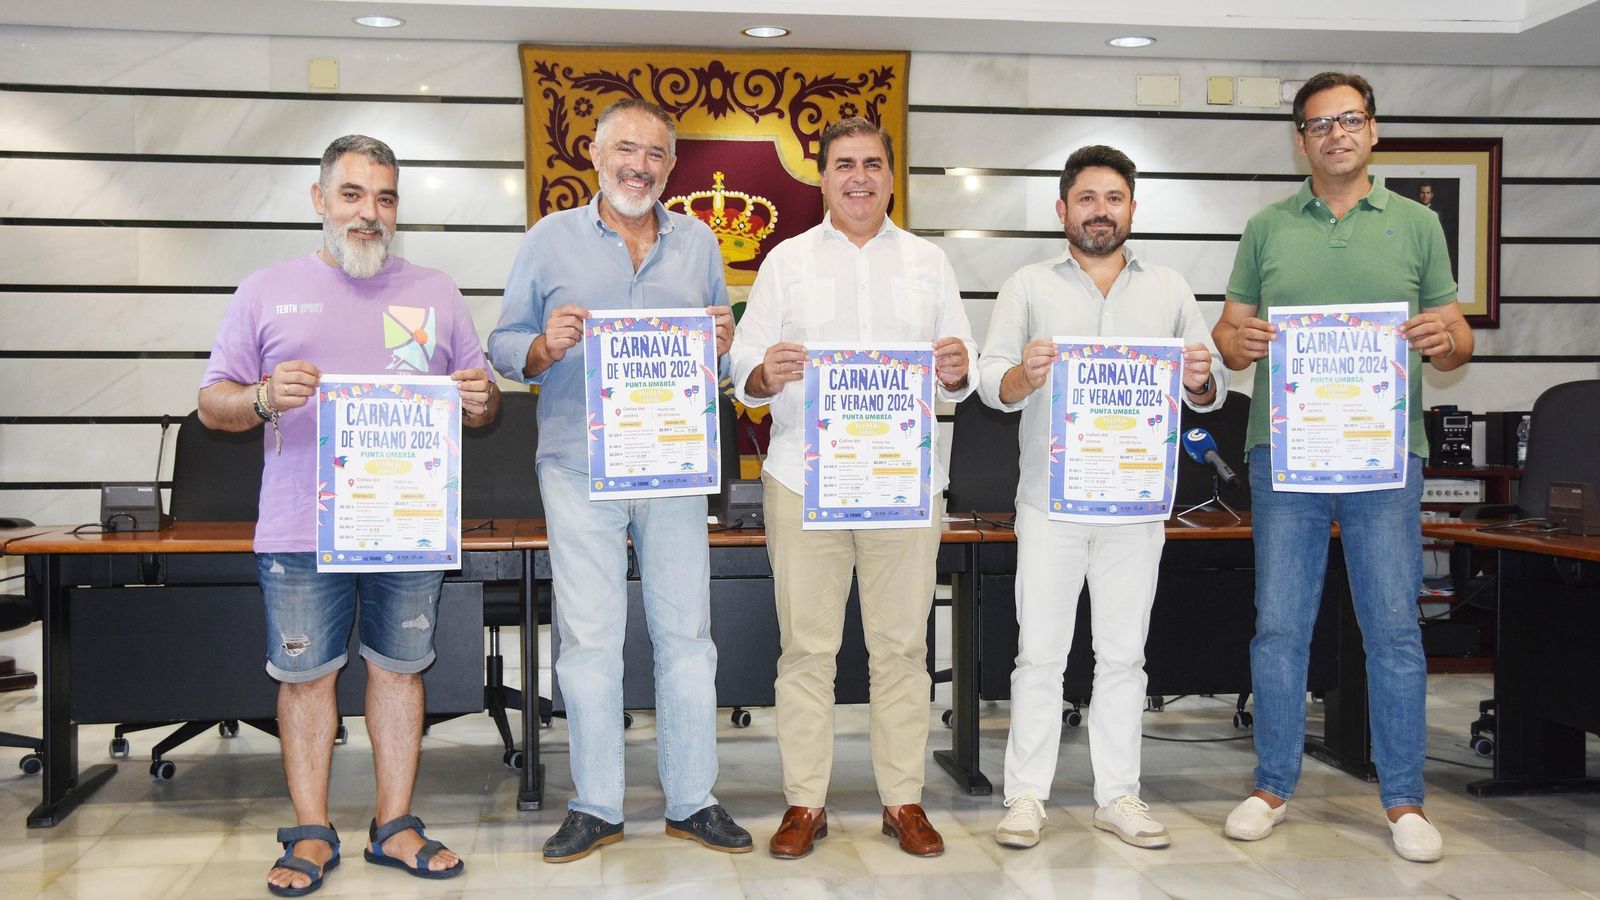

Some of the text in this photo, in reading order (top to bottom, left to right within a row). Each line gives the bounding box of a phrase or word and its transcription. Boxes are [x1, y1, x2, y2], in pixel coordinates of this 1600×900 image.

[276, 304, 297, 314] TENTH
[607, 360, 698, 379] DE VERANO 2024
[1292, 356, 1388, 374] DE VERANO 2024
[825, 394, 915, 412] DE VERANO 2024
[1072, 388, 1163, 407] DE VERANO 2024
[341, 430, 440, 449] DE VERANO 2024
